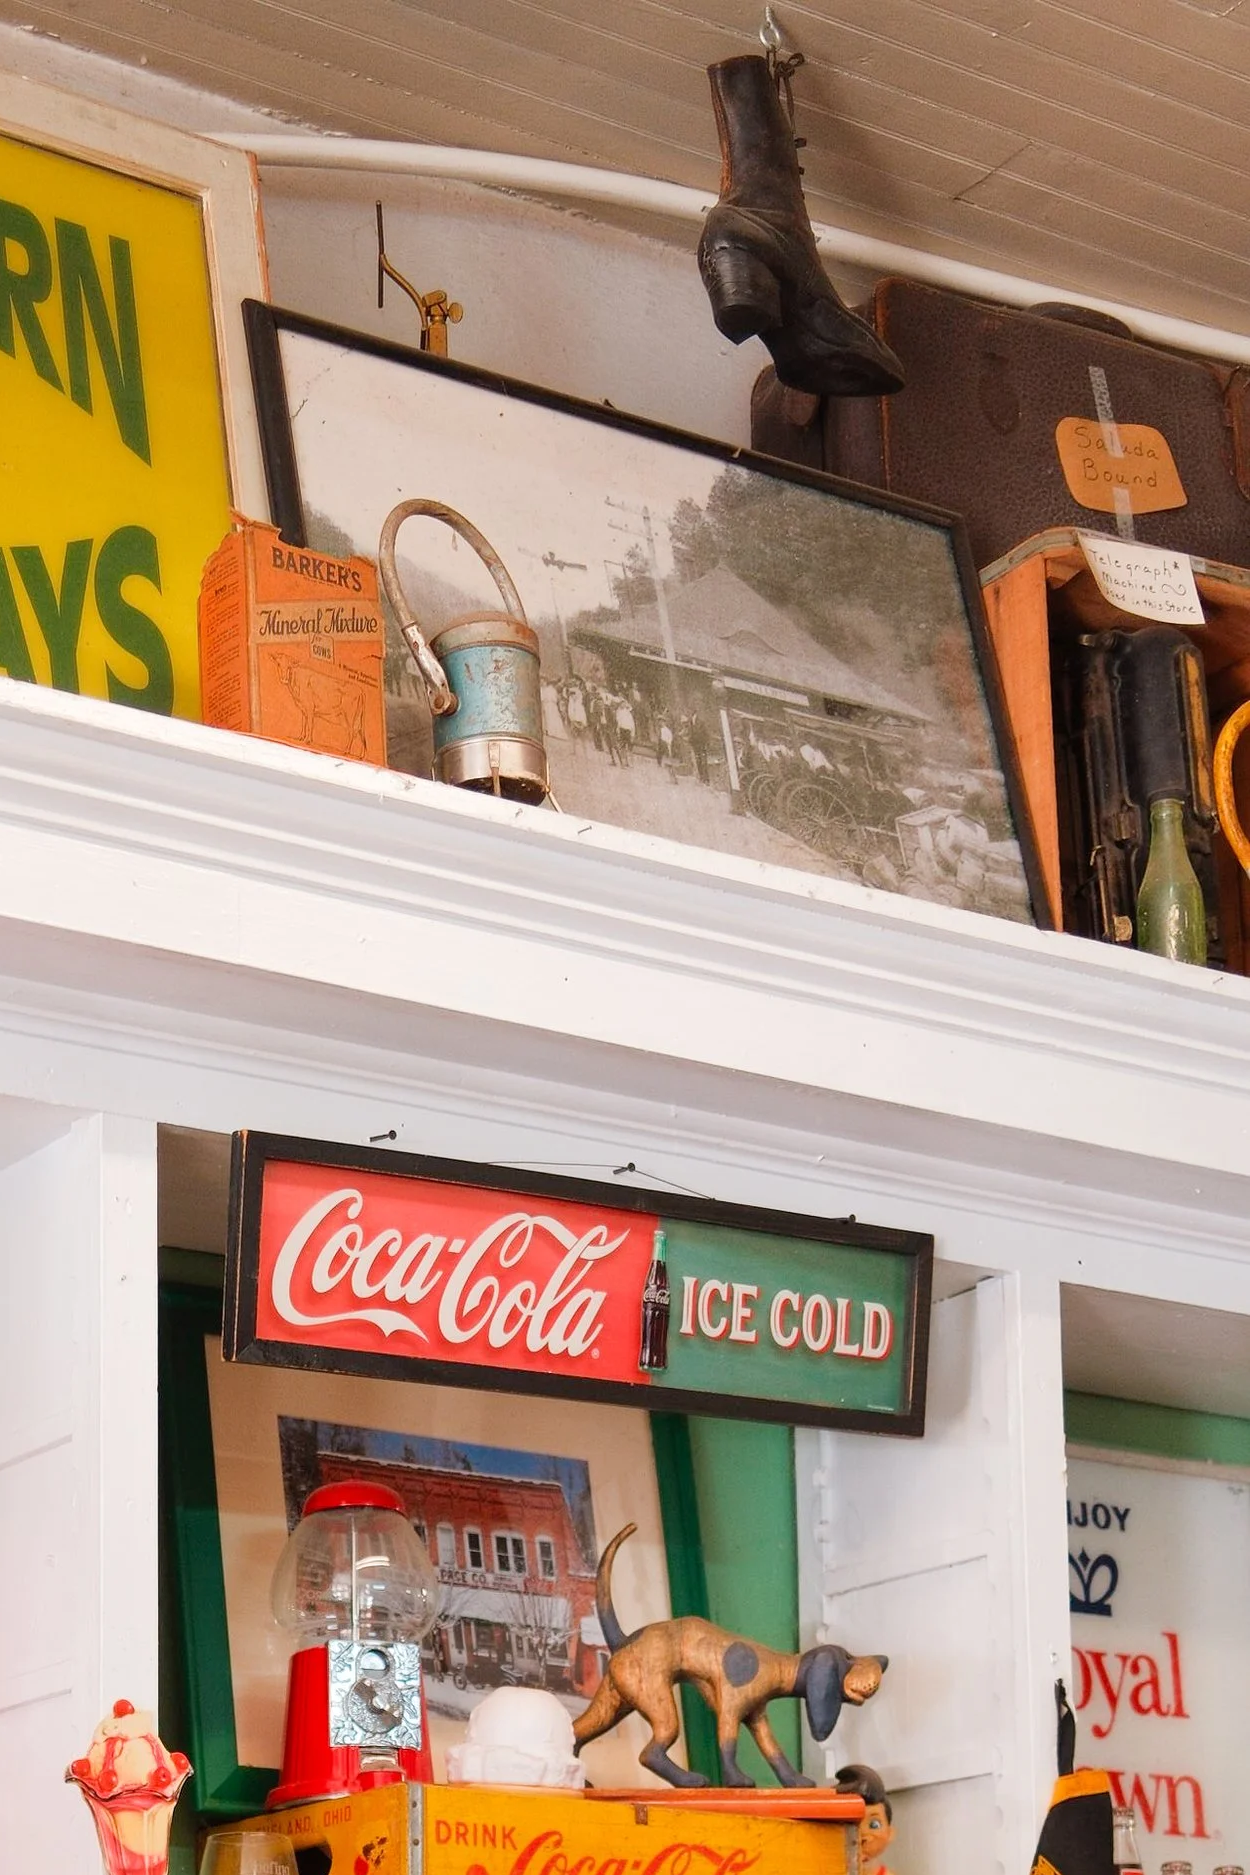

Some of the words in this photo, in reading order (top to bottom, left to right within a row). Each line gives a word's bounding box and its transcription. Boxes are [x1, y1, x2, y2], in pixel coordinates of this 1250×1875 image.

[1082, 458, 1158, 488] Bound
[272, 546, 363, 592] BARKER'S
[258, 608, 323, 636] Mineral
[323, 607, 379, 639] Mixture
[312, 644, 332, 660] COWS
[271, 1188, 630, 1358] Coca-Cola
[679, 1276, 760, 1343] ICE
[769, 1289, 895, 1361] COLD
[1068, 1502, 1131, 1532] JOY
[1072, 1631, 1190, 1740] oyal
[323, 1805, 352, 1828] OHIO
[435, 1819, 518, 1850] DRINK
